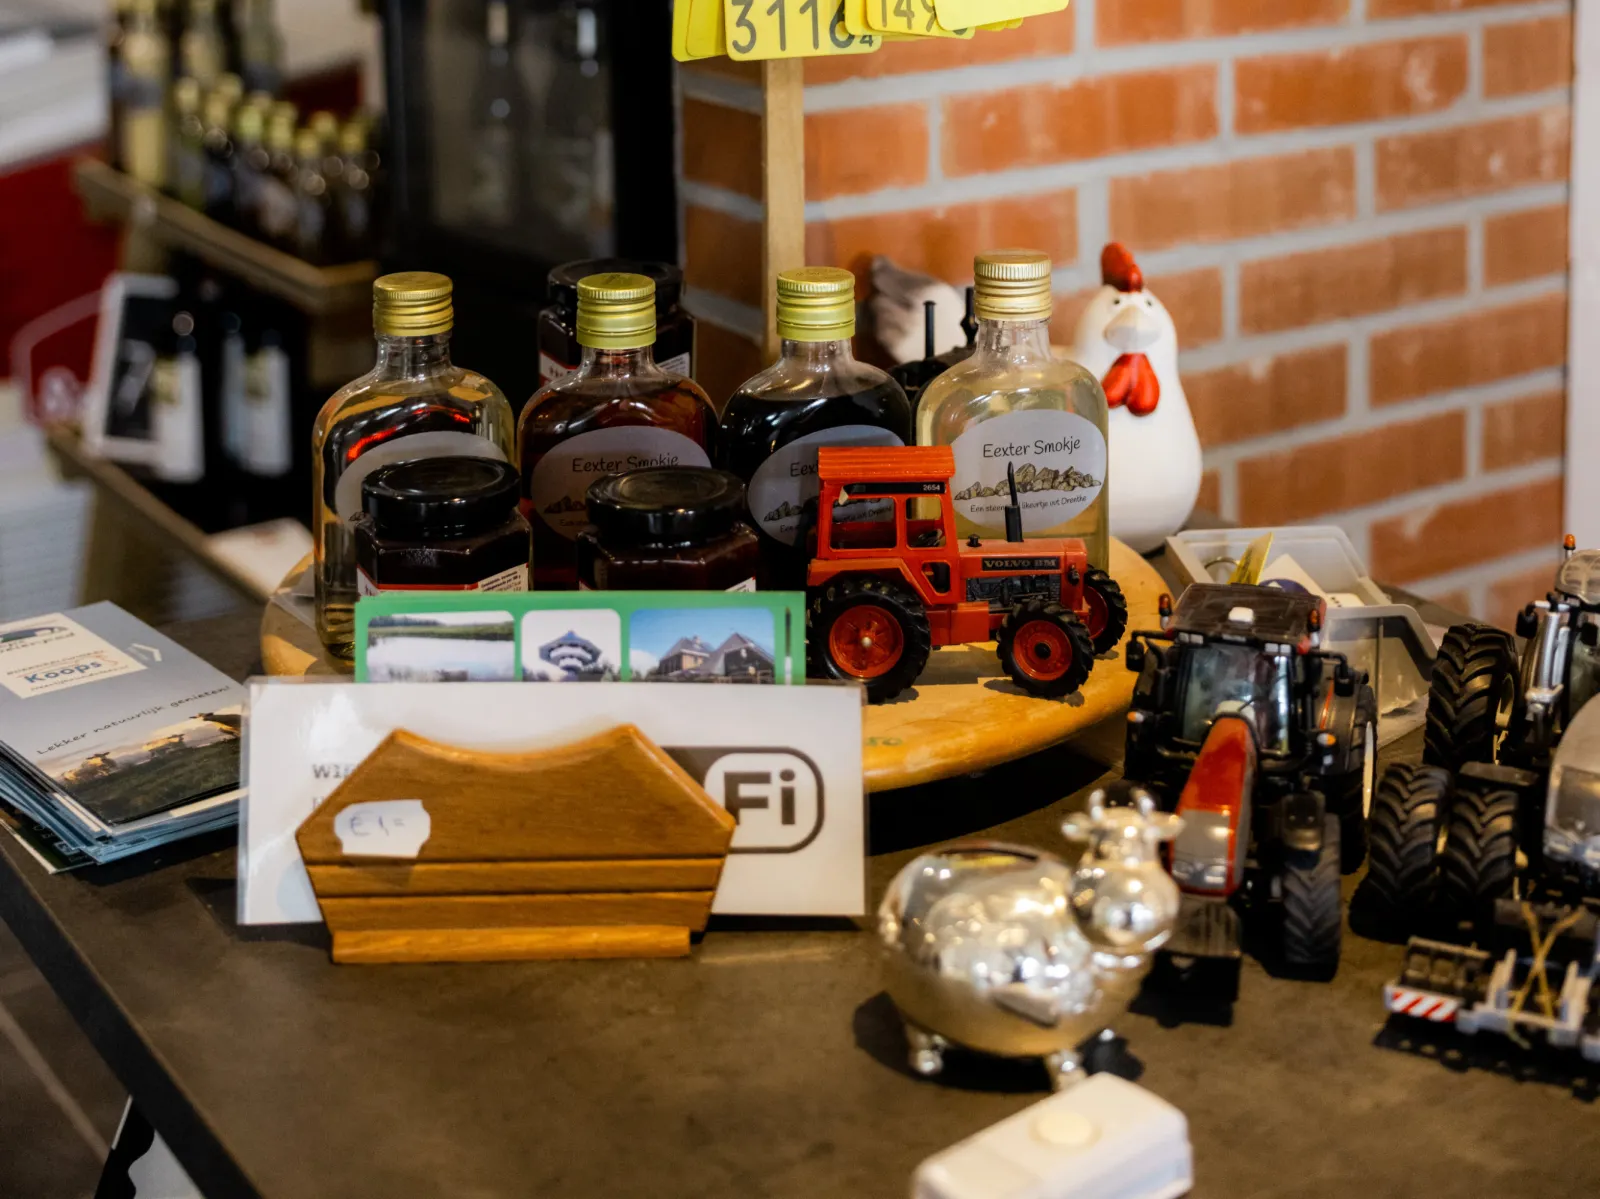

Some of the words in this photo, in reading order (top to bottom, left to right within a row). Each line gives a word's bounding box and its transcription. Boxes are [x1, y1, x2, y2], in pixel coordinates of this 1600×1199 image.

[983, 443, 1030, 458] Eexter
[1034, 436, 1081, 455] Smokje
[572, 457, 622, 473] Eexter
[790, 462, 819, 477] Eex
[970, 504, 984, 513] Een
[984, 559, 1031, 568] VOLVO
[24, 661, 102, 683] Koops
[36, 732, 88, 755] Lekker
[93, 705, 165, 733] natuurlijk
[170, 685, 231, 708] genieten!
[724, 768, 796, 826] Fi
